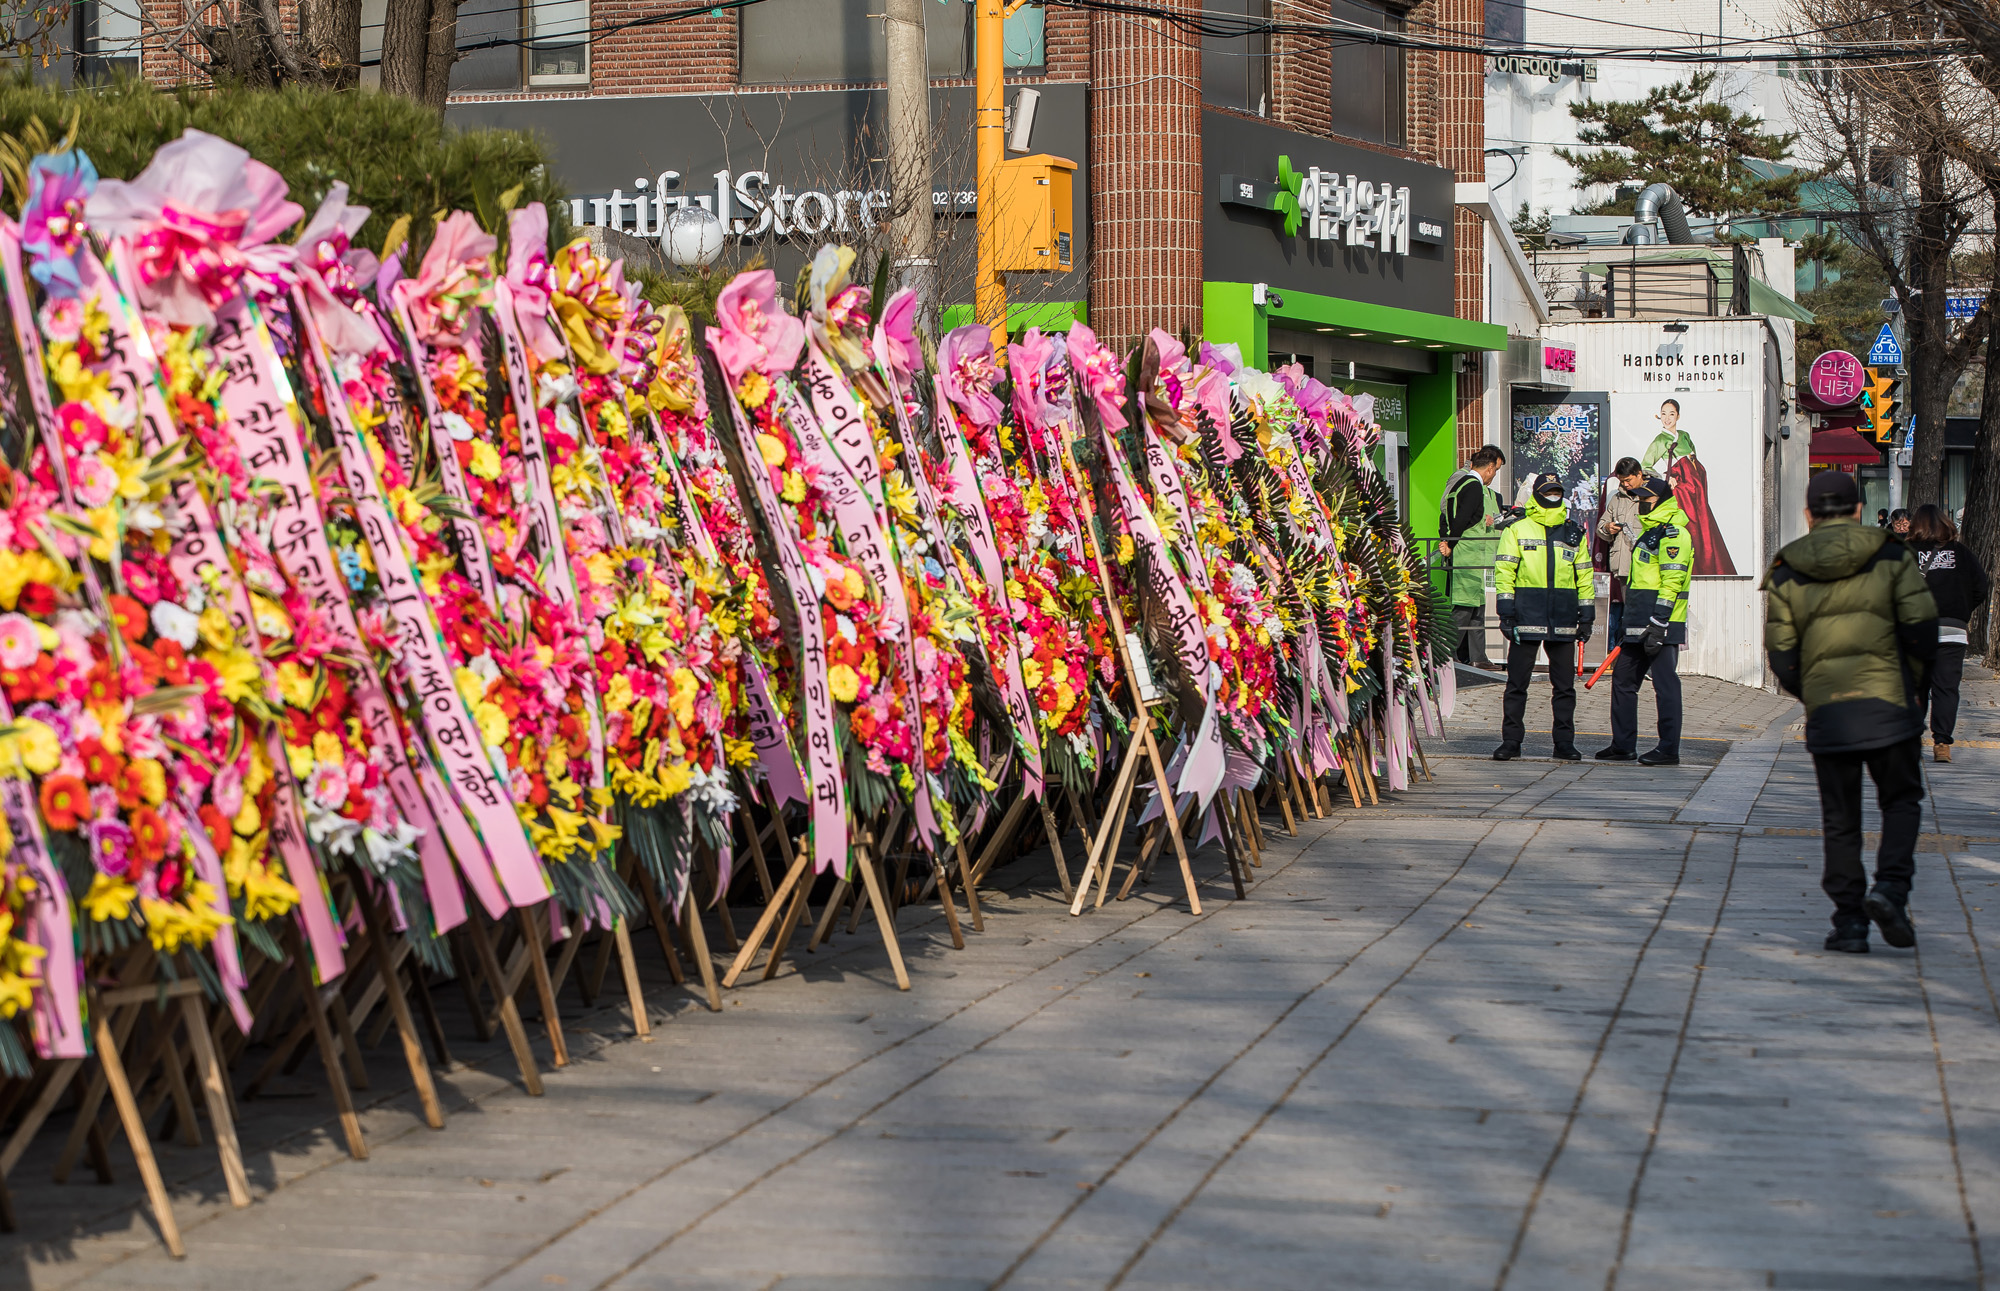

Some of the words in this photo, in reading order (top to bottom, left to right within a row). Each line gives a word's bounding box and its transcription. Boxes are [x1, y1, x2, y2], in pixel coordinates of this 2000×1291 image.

[1298, 166, 1410, 256] 아름다운가게
[1623, 353, 1686, 367] Hanbok
[1694, 352, 1745, 366] rental
[1820, 359, 1856, 377] 인생
[1643, 372, 1671, 382] Miso
[1678, 371, 1724, 382] Hanbok
[1818, 379, 1854, 398] 네컷
[1374, 397, 1402, 421] 름다운하루
[1522, 415, 1590, 434] 미소한복
[1918, 550, 1956, 564] NKE
